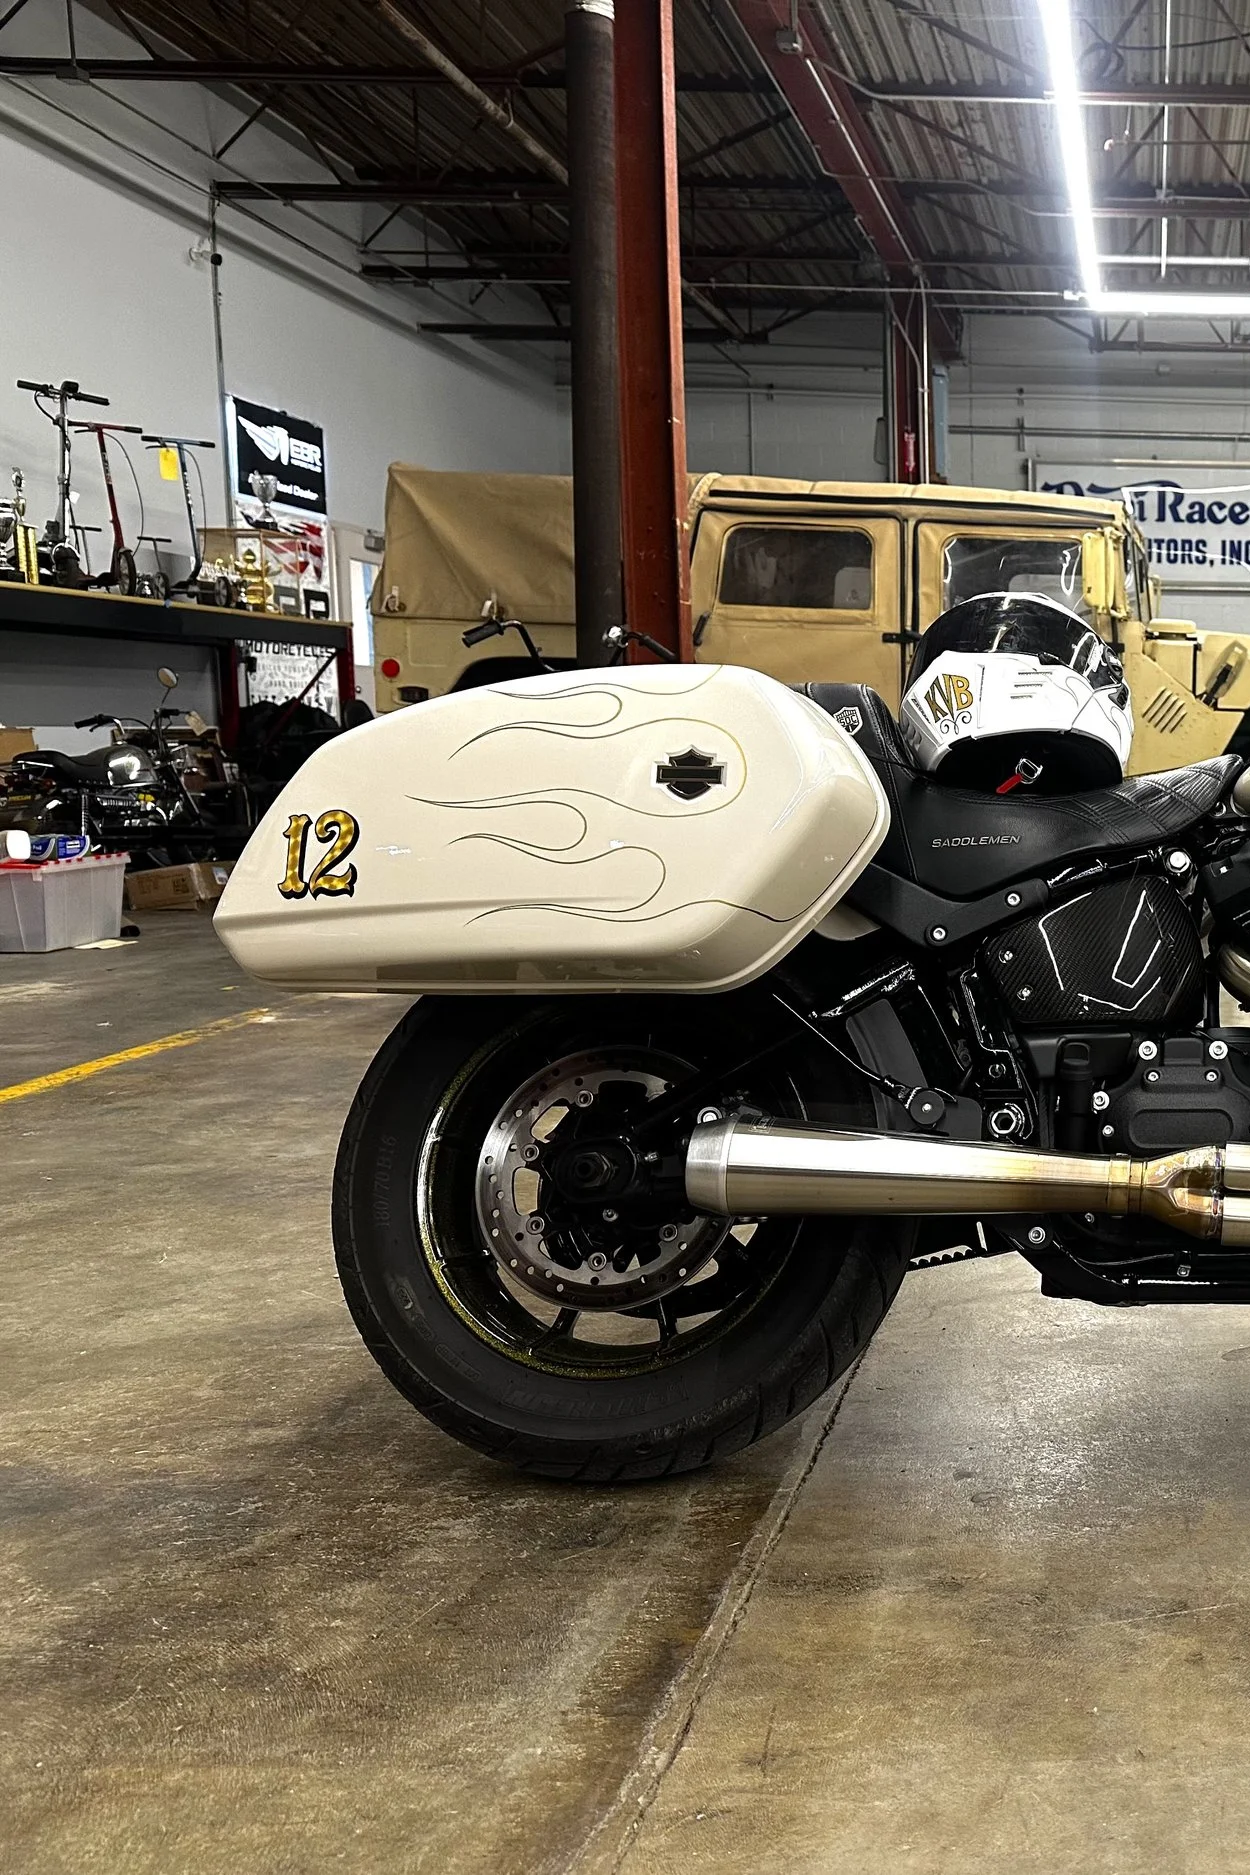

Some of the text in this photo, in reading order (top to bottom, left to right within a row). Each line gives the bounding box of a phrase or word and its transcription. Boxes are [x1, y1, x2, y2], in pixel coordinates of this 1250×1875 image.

[1148, 538, 1215, 567] TORS,
[924, 673, 974, 723] KVB
[277, 809, 360, 900] 12
[931, 835, 1021, 848] SADDLEMEN
